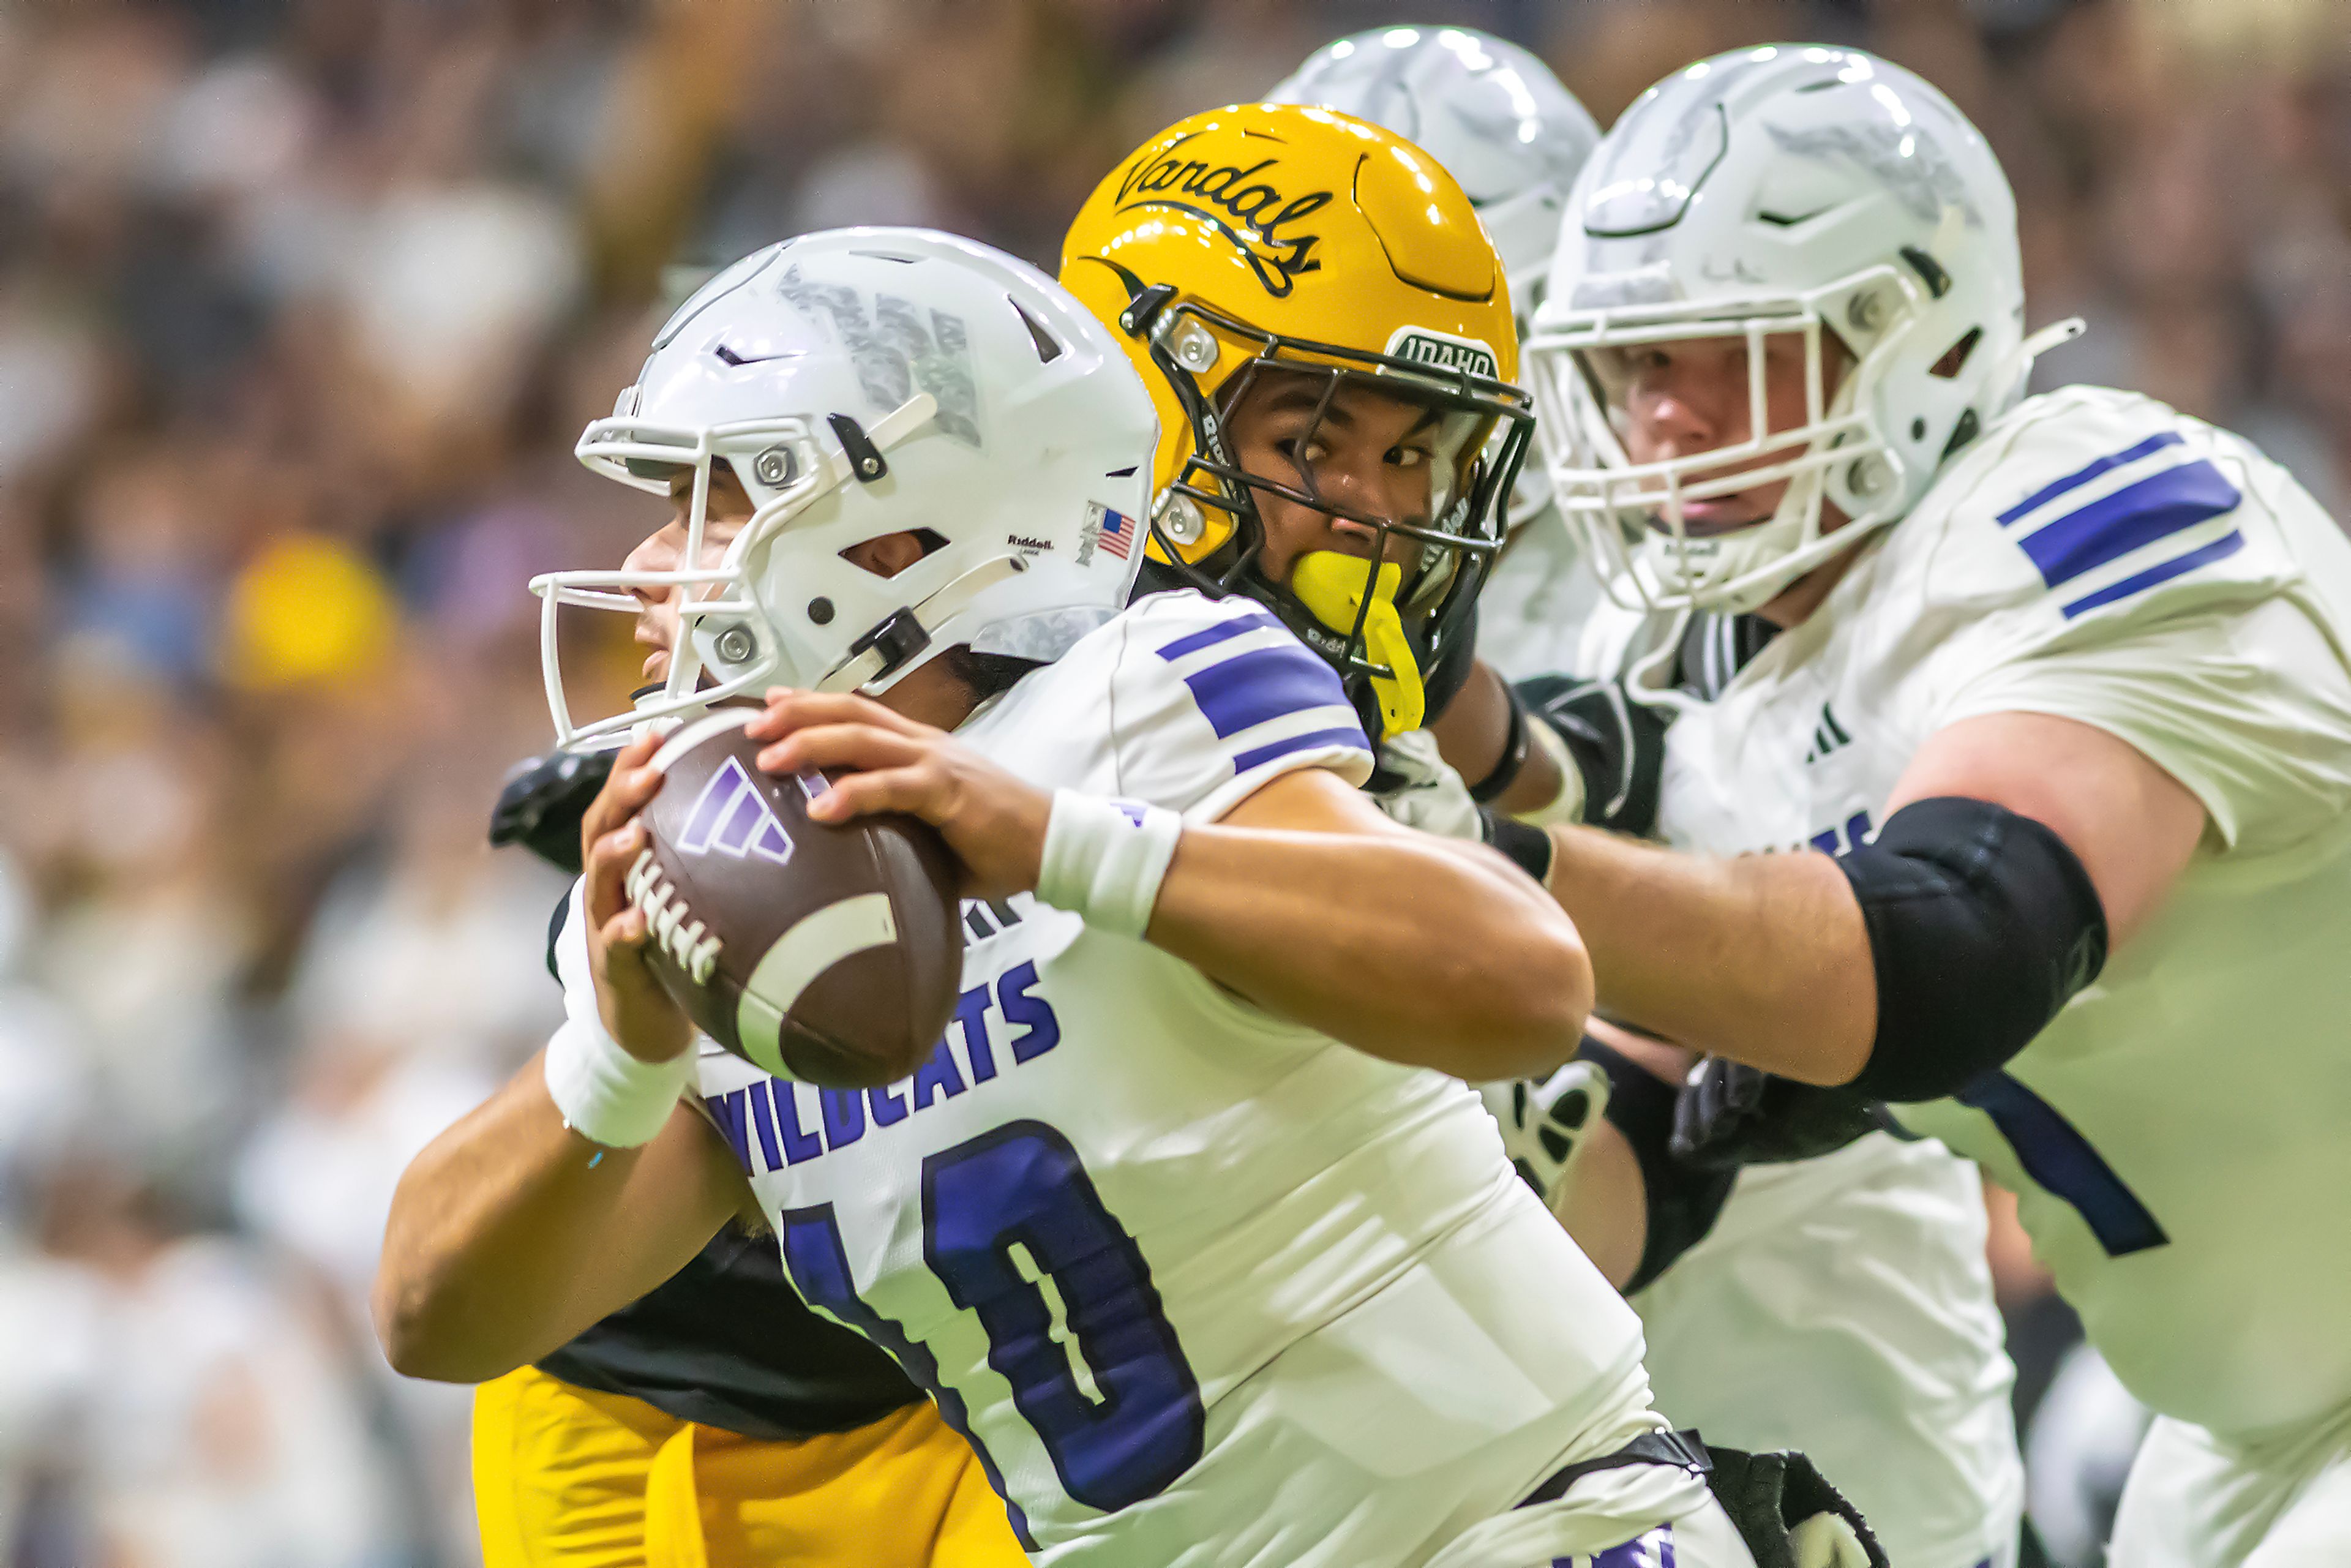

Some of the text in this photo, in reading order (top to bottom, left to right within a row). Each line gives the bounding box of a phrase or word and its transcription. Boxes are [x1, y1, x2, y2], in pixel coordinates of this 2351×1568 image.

[1116, 131, 1333, 297] Vandals
[1406, 337, 1490, 375] IDAHO
[782, 1119, 1206, 1554] 10
